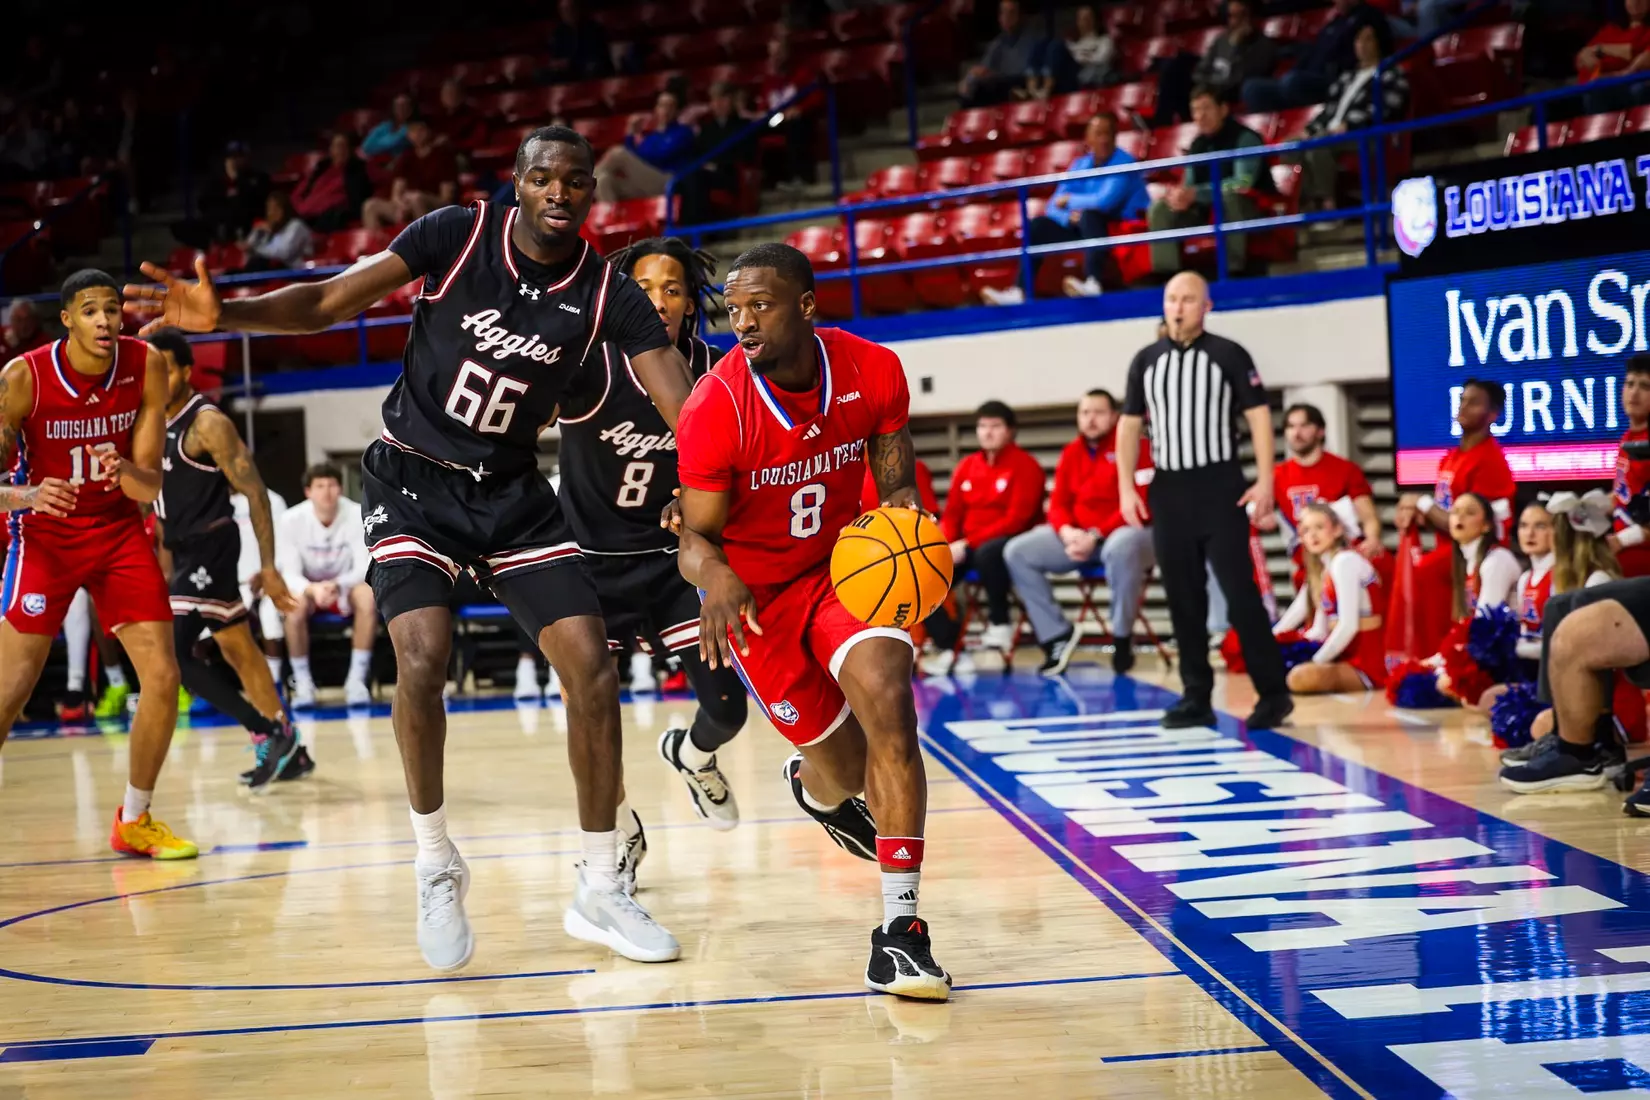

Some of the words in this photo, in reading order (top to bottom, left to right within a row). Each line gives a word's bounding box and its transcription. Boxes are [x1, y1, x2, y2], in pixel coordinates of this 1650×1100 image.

[1444, 158, 1635, 238] LOUISIANA
[460, 308, 562, 365] Aggies
[1445, 289, 1579, 367] Ivan
[444, 357, 532, 434] 66
[46, 415, 109, 440] LOUISIANA
[599, 420, 677, 459] Aggie
[616, 461, 655, 508] 8
[750, 451, 831, 490] LOUISIANA
[789, 482, 827, 539] 8
